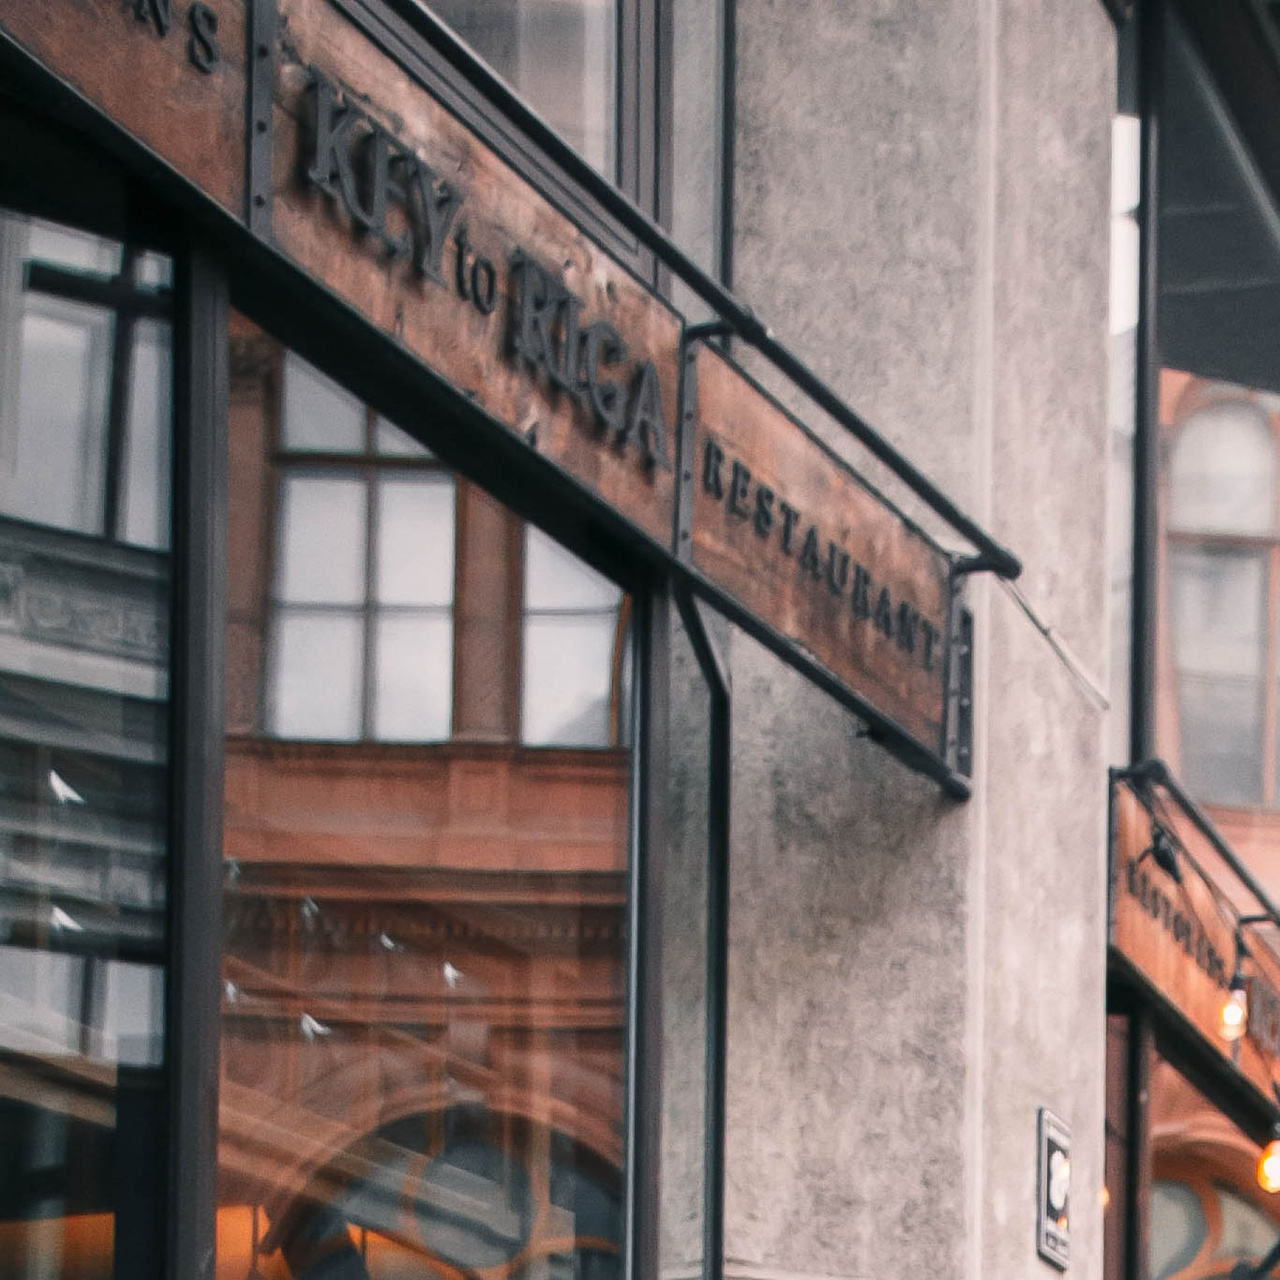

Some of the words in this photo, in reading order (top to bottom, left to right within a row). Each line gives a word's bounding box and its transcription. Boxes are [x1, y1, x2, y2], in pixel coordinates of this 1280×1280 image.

[303, 74, 466, 290] KEY
[453, 224, 496, 315] to
[514, 250, 674, 474] RIGA
[702, 436, 940, 674] RESTAURANT
